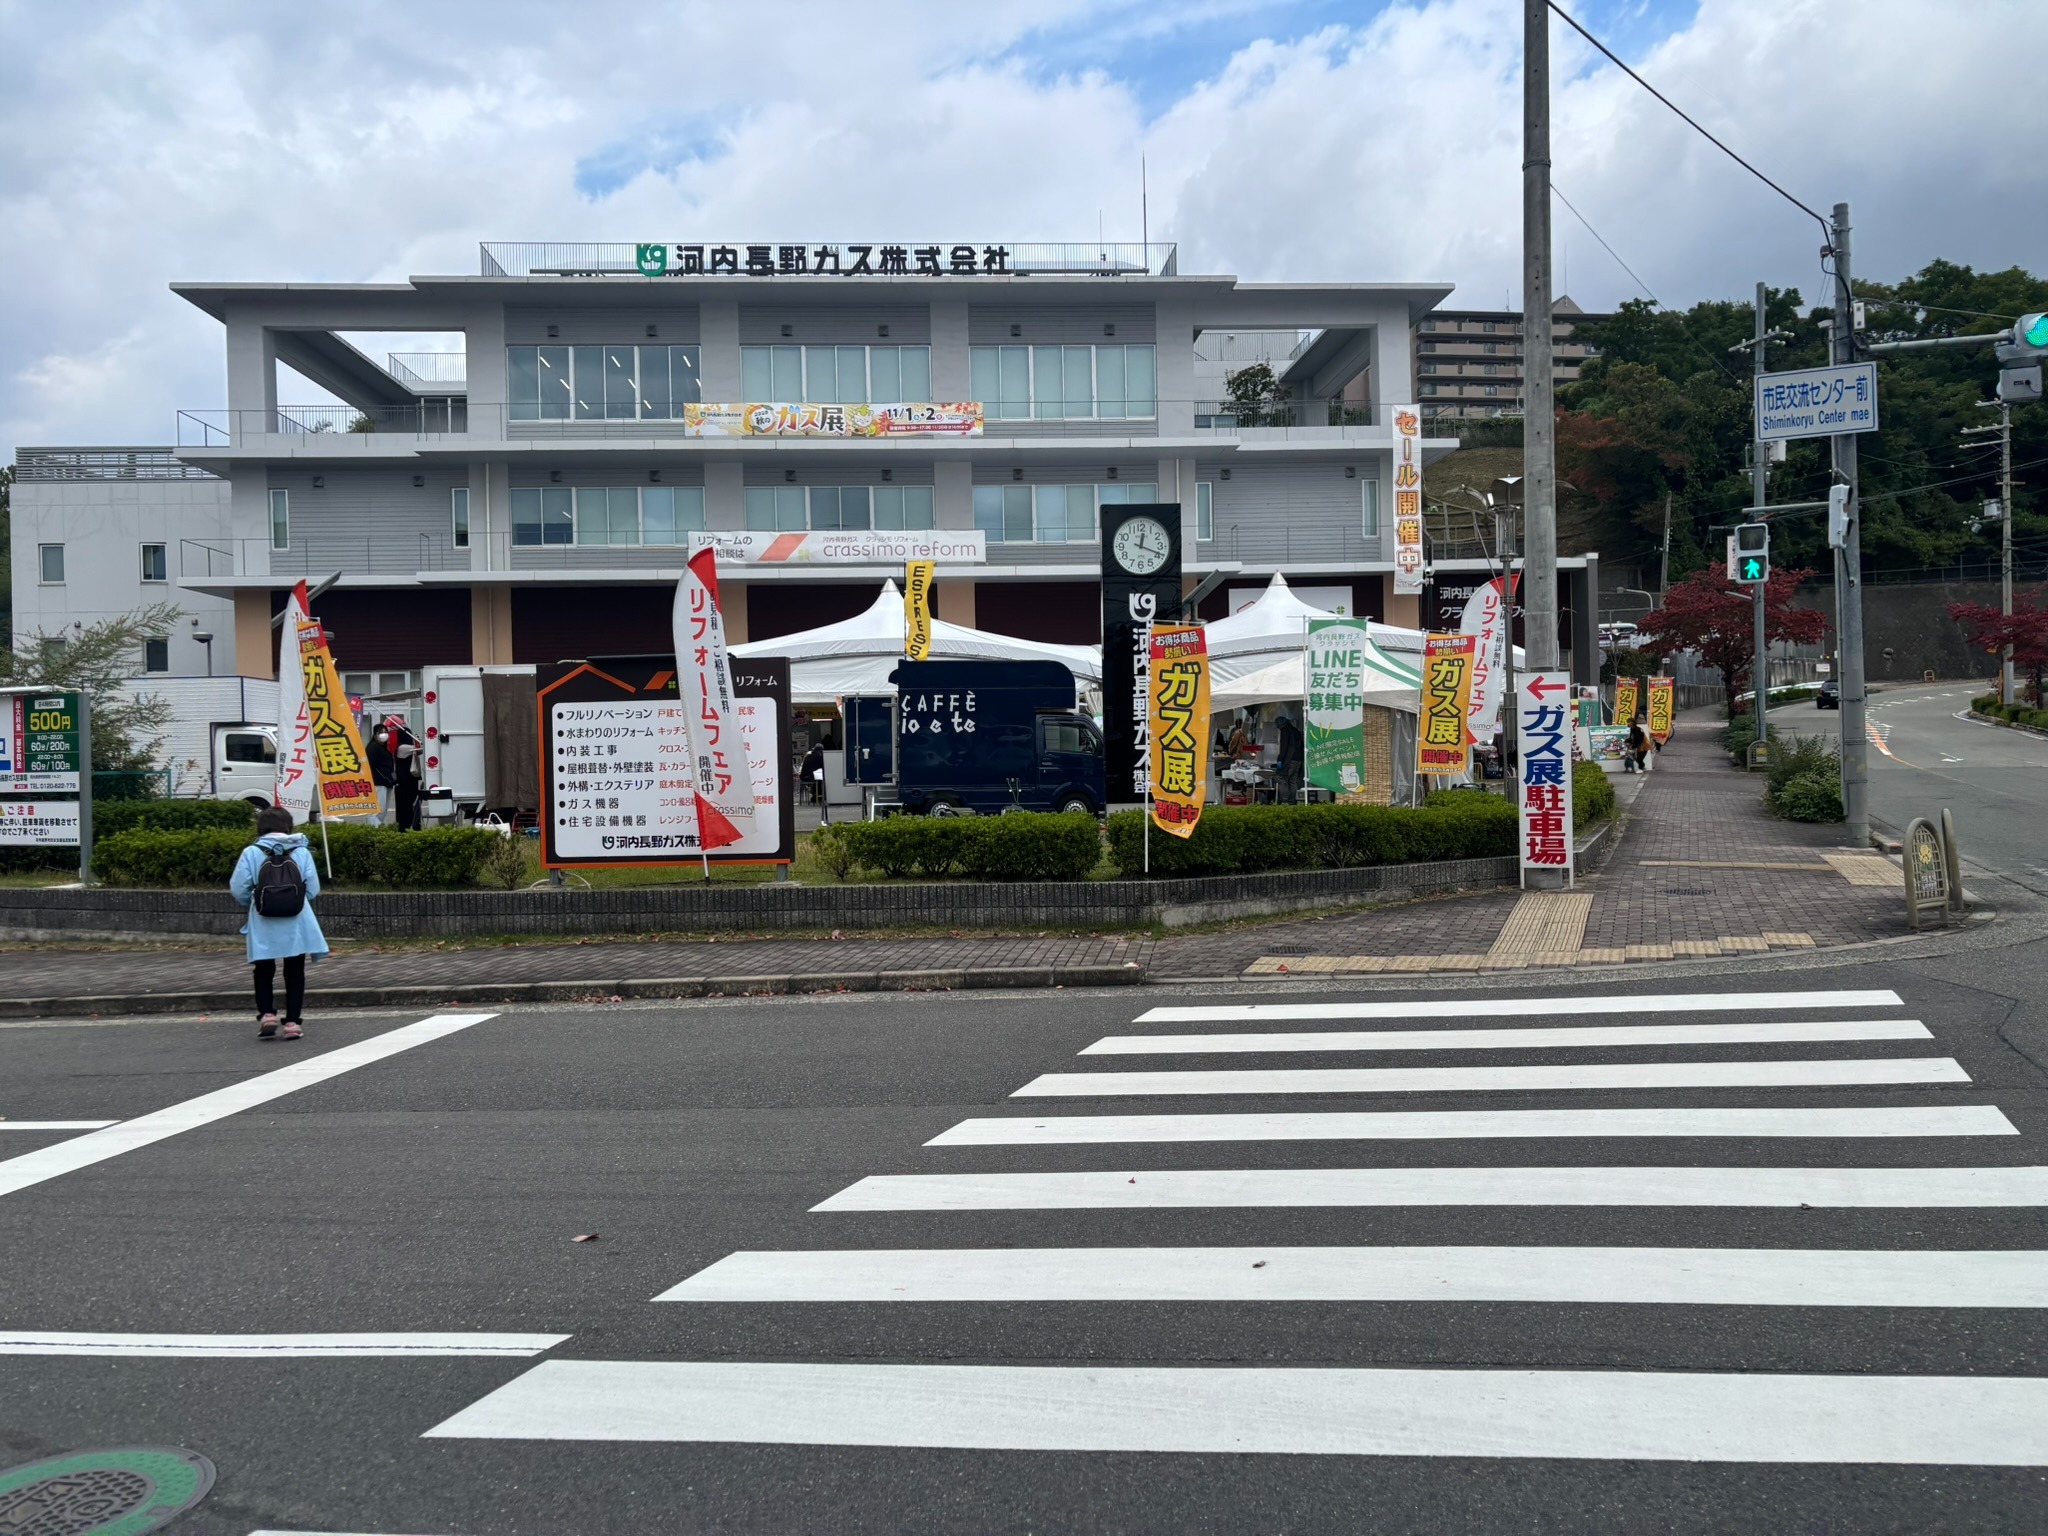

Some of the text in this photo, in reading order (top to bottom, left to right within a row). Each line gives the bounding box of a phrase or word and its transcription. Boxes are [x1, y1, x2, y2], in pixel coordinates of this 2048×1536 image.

[676, 245, 1010, 276] 河内長野ガス株式会社
[1763, 375, 1868, 412] 市民交流センター前
[775, 405, 845, 432] ガス展
[1763, 408, 1869, 430] Shiminkoryu Center mae
[1396, 411, 1420, 574] セール開催中
[1129, 525, 1135, 534] 11
[1137, 523, 1146, 532] 12
[698, 536, 752, 546] リフォームの
[1119, 532, 1129, 541] 10
[1154, 532, 1161, 540] 2
[823, 541, 976, 557] crassimo reform
[1118, 542, 1124, 551] 9
[1157, 541, 1163, 550] 3
[1121, 551, 1128, 560] 8
[1147, 558, 1154, 567] 5
[1129, 559, 1135, 567] 7
[1137, 560, 1144, 569] 6
[910, 565, 926, 660] ESPRESS
[1155, 632, 1199, 646] お得な商品
[1315, 632, 1360, 641] 河内長野ガス
[1429, 638, 1468, 647] お得な商品
[1311, 649, 1362, 668] LINE
[1468, 595, 1498, 716] リフォームフェア
[736, 675, 778, 686] リフォーム
[1310, 672, 1360, 688] 友だち
[690, 588, 732, 795] リフォームフェア
[901, 690, 976, 712] CAFFÈ
[1309, 692, 1362, 711] 募集中
[1425, 658, 1465, 745] ガス展
[303, 655, 362, 775] ガス展
[566, 706, 755, 720] フルリノベーション 戸建て 民家
[1651, 688, 1669, 730] ガス展
[30, 712, 71, 731] 500円
[929, 719, 942, 733] e
[951, 711, 976, 733] te
[1157, 661, 1201, 796] ガス展
[566, 727, 653, 739] 水まわりのリフォーム
[566, 745, 617, 757] 内装工事
[1421, 749, 1463, 764] 開催中
[567, 761, 655, 774] 屋根葺替・外壁塗装
[698, 755, 714, 795] 開催中
[322, 779, 373, 800] 開催中
[568, 780, 655, 792] 外構・エクステリア
[659, 780, 693, 789] 庭木剪定
[1521, 704, 1567, 864] ガス展駐車場
[8, 805, 35, 815] ご注意
[568, 798, 619, 810] ガス機器
[706, 806, 752, 815] crassimo
[1155, 799, 1199, 824] 開催中
[568, 815, 646, 827] 住宅設備機器
